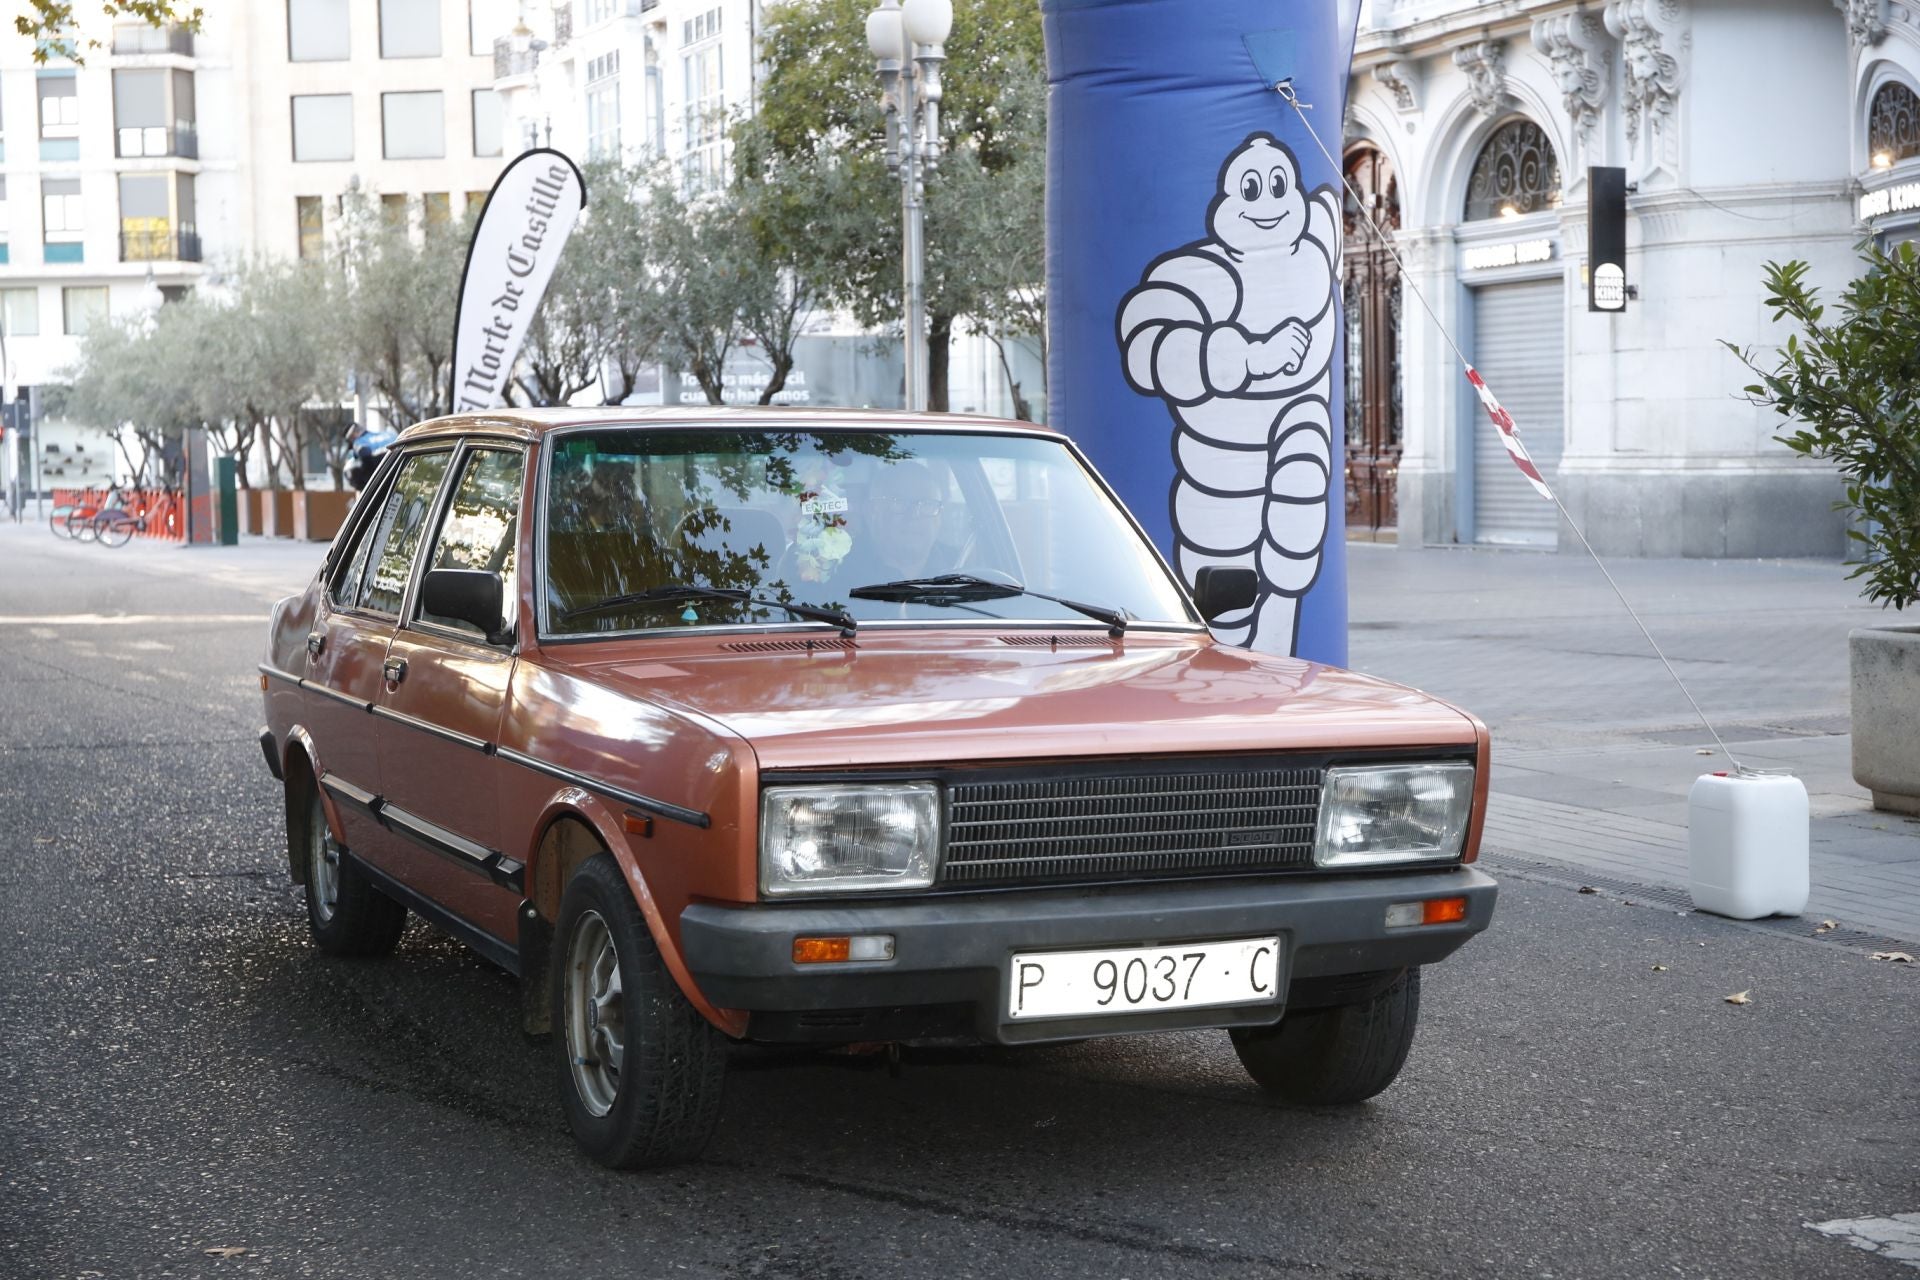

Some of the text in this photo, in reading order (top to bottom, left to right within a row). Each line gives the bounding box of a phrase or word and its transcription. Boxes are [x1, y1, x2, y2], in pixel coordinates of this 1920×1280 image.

[506, 165, 569, 277] Castilla
[491, 280, 524, 312] de
[1594, 287, 1624, 300] KING
[464, 315, 513, 393] Norte
[738, 371, 770, 386] más
[778, 371, 805, 385] cil
[680, 388, 809, 402] cuao habamos
[1231, 831, 1274, 844] SEAT
[1018, 947, 1270, 1010] P 9037 C
